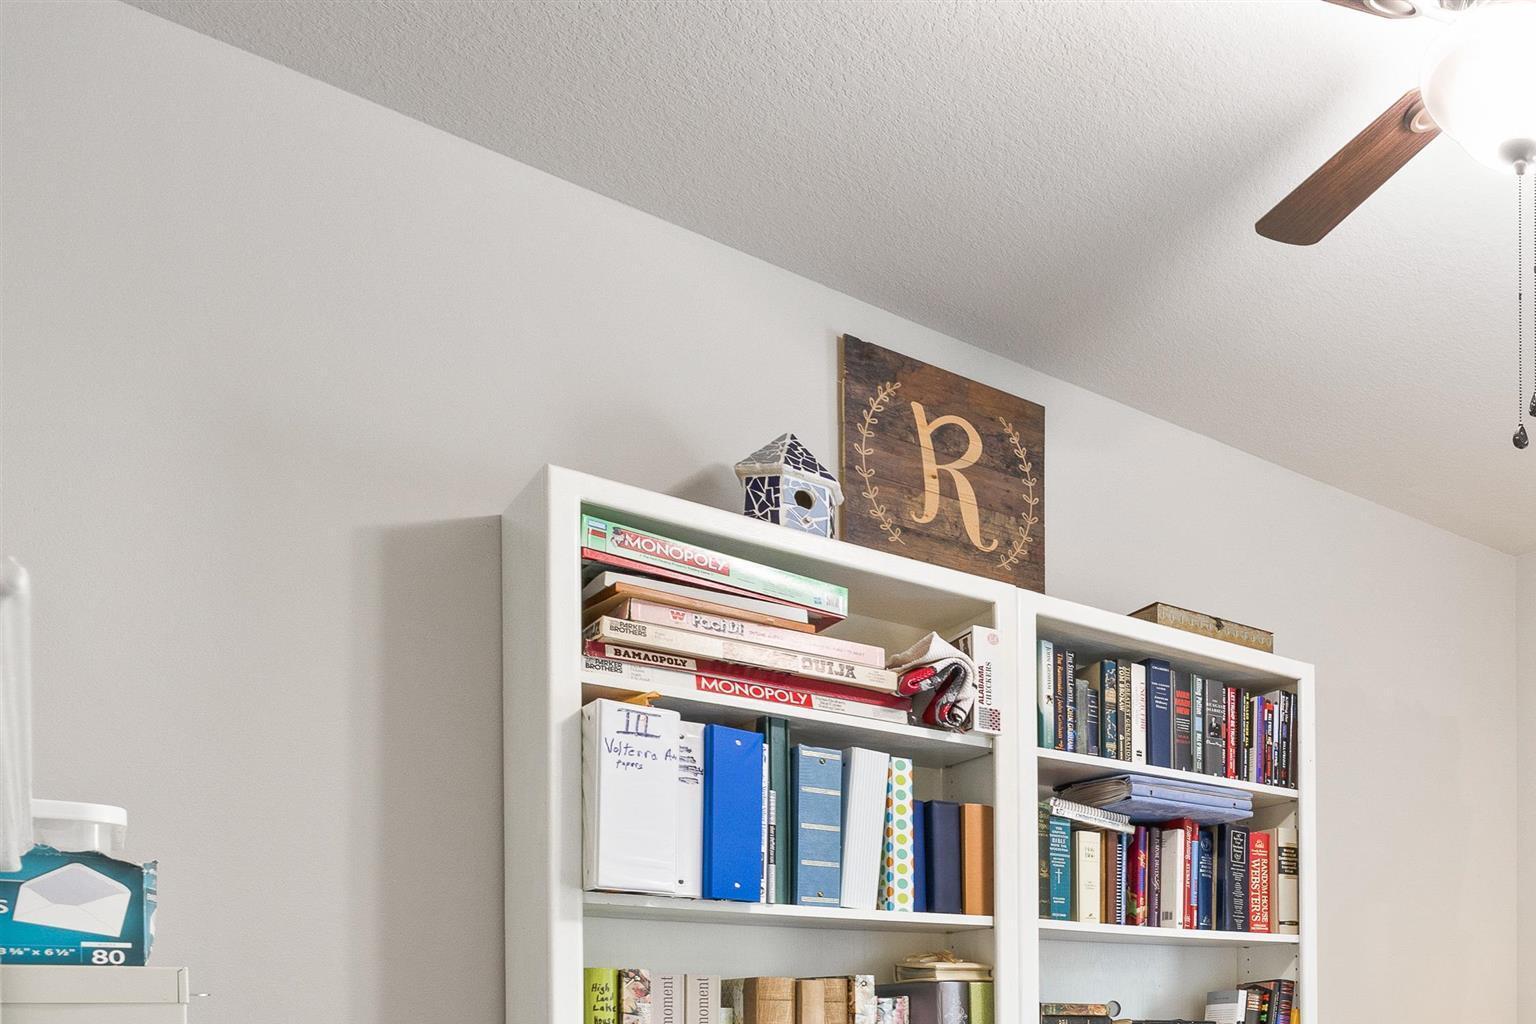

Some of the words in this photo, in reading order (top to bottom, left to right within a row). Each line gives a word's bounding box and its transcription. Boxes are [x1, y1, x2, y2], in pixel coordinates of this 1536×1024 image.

[910, 401, 998, 552] R
[625, 533, 728, 571] MONOPOLY
[609, 625, 647, 637] BROTHERS
[619, 621, 647, 632] PARKER
[594, 658, 623, 668] PARKER
[614, 648, 688, 667] BAMAOPOLY
[585, 662, 623, 674] BROTHERS
[801, 657, 856, 679] OUIJA
[701, 677, 808, 705] MONOPOLY
[1230, 720, 1235, 728] BE
[1261, 858, 1269, 894] RANDOM
[1251, 858, 1260, 922] WEBSTER'S
[1261, 895, 1269, 923] HOUSE
[91, 949, 126, 965] 80
[591, 983, 610, 995] High
[593, 1003, 616, 1012] Lake
